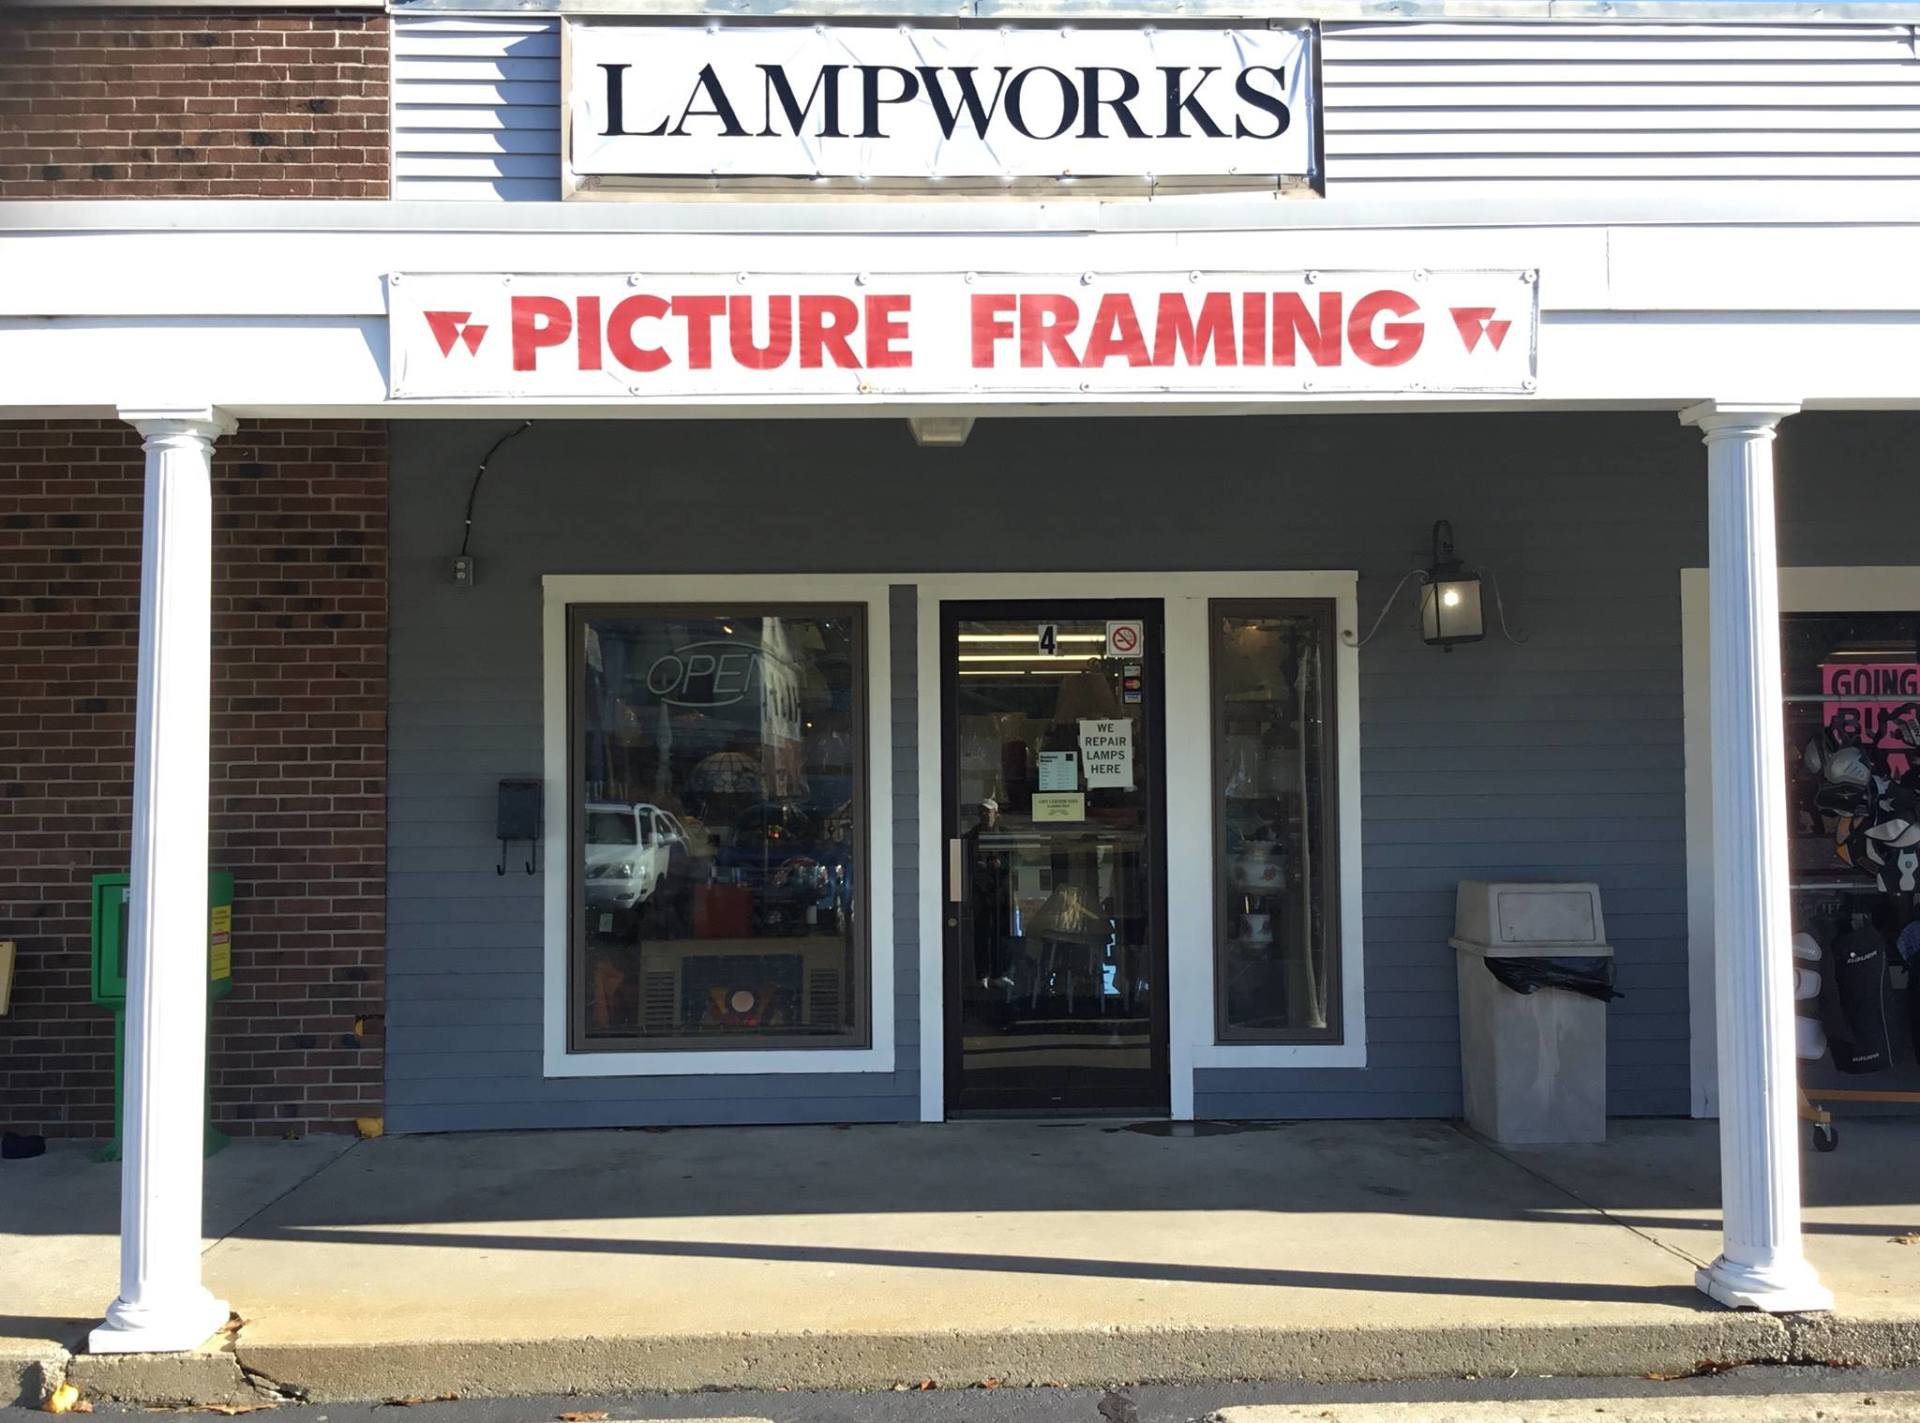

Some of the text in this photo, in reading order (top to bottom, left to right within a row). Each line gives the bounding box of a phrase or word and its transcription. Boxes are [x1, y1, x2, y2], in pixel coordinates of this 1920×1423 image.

[597, 63, 1289, 139] LAMPWORKS
[511, 289, 1425, 371] PICTURE FRAMING
[1040, 626, 1055, 654] 4
[1831, 668, 1918, 697] GOING
[1097, 723, 1114, 733] WE
[1085, 736, 1127, 747] REPAIR
[1086, 750, 1126, 760] LAMPS
[1091, 764, 1121, 774] HERE
